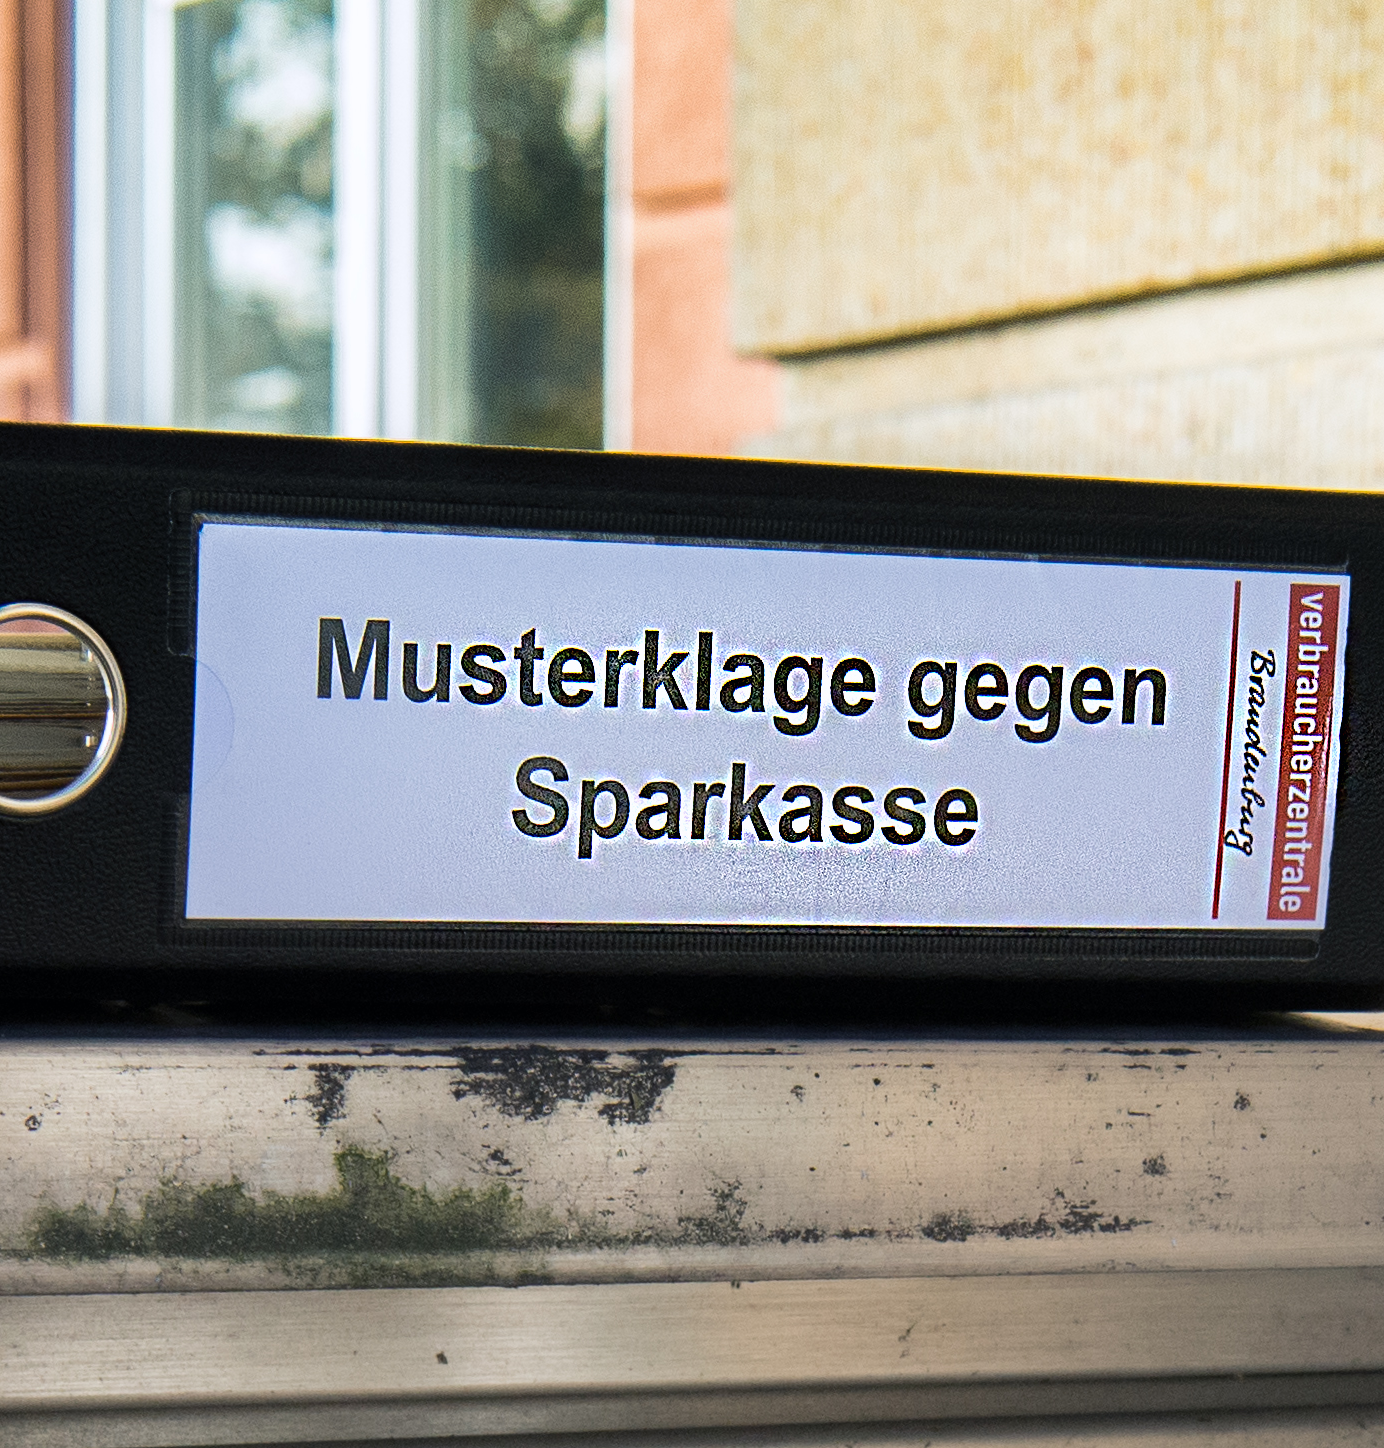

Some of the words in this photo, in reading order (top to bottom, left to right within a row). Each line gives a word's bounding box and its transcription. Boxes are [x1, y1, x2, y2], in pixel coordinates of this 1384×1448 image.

[316, 616, 877, 737] Musterklage
[907, 660, 1167, 744] gegen
[1223, 649, 1276, 857] Brandenburg
[1278, 591, 1329, 913] verbraucherzentrale
[510, 756, 979, 860] Sparkasse
